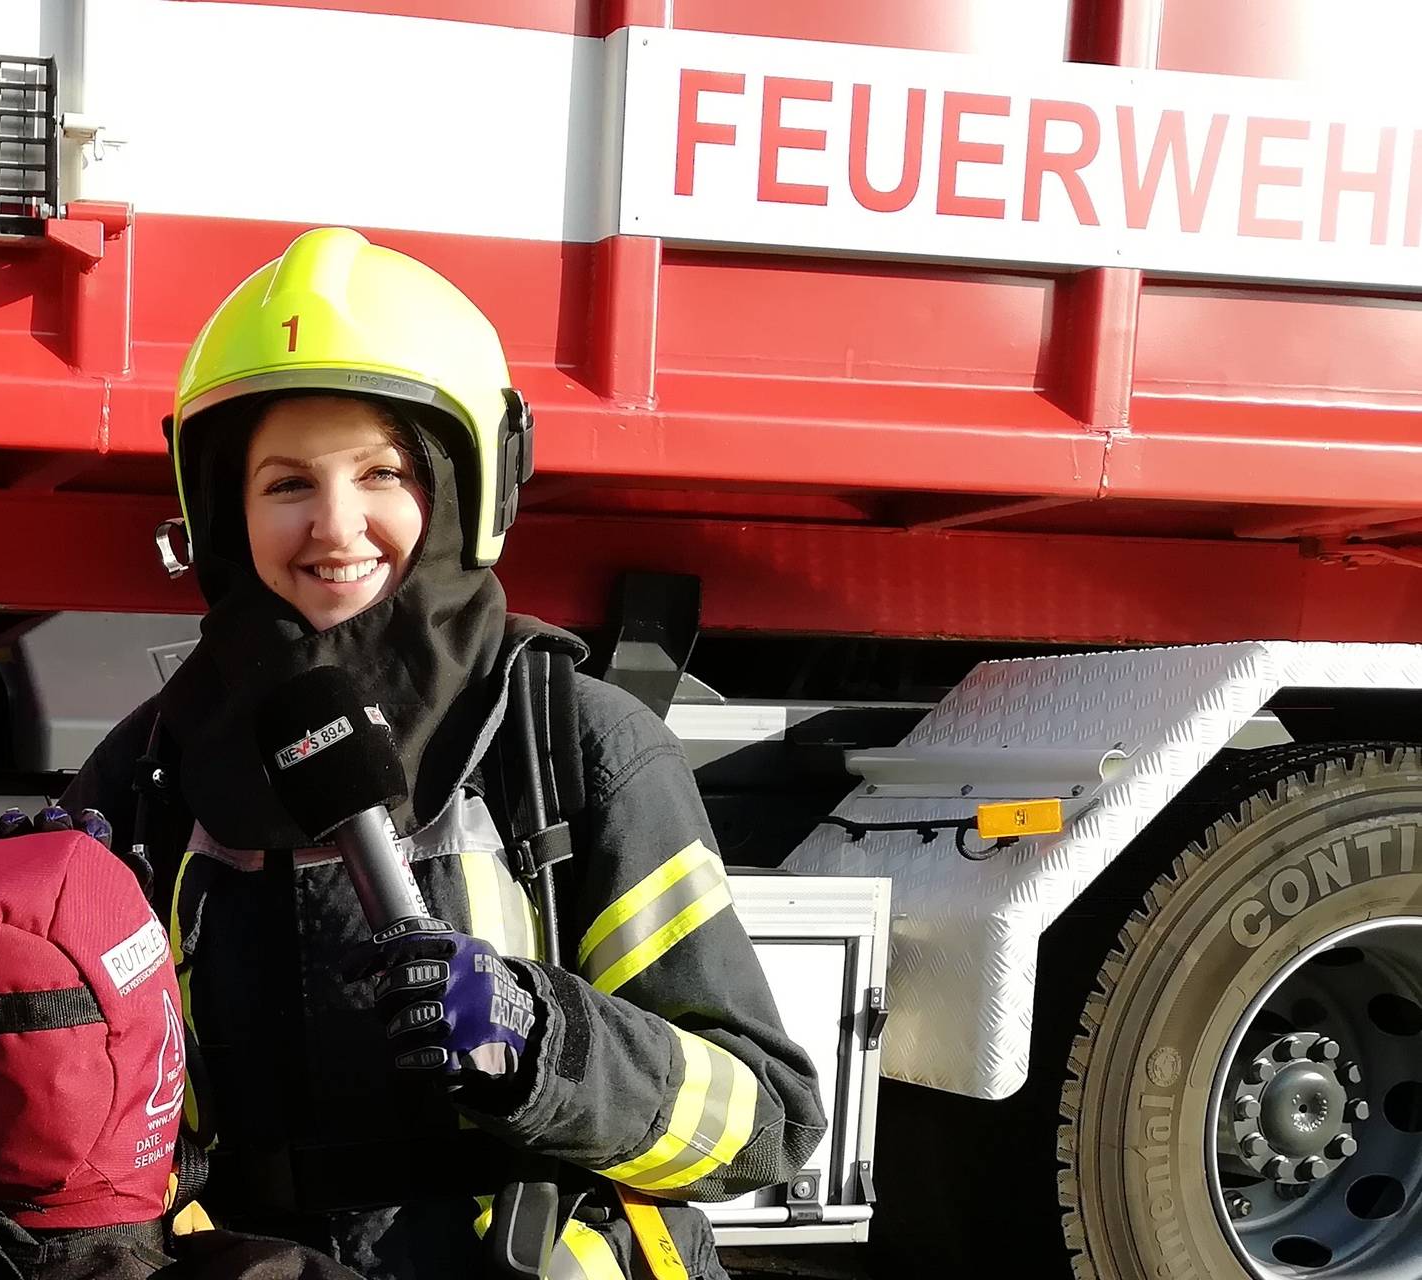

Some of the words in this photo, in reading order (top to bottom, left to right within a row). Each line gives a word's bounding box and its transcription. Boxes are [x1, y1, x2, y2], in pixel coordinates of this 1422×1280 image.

[282, 315, 299, 352] 1
[136, 1132, 162, 1153] DATE:
[134, 1147, 165, 1169] SERIAL
